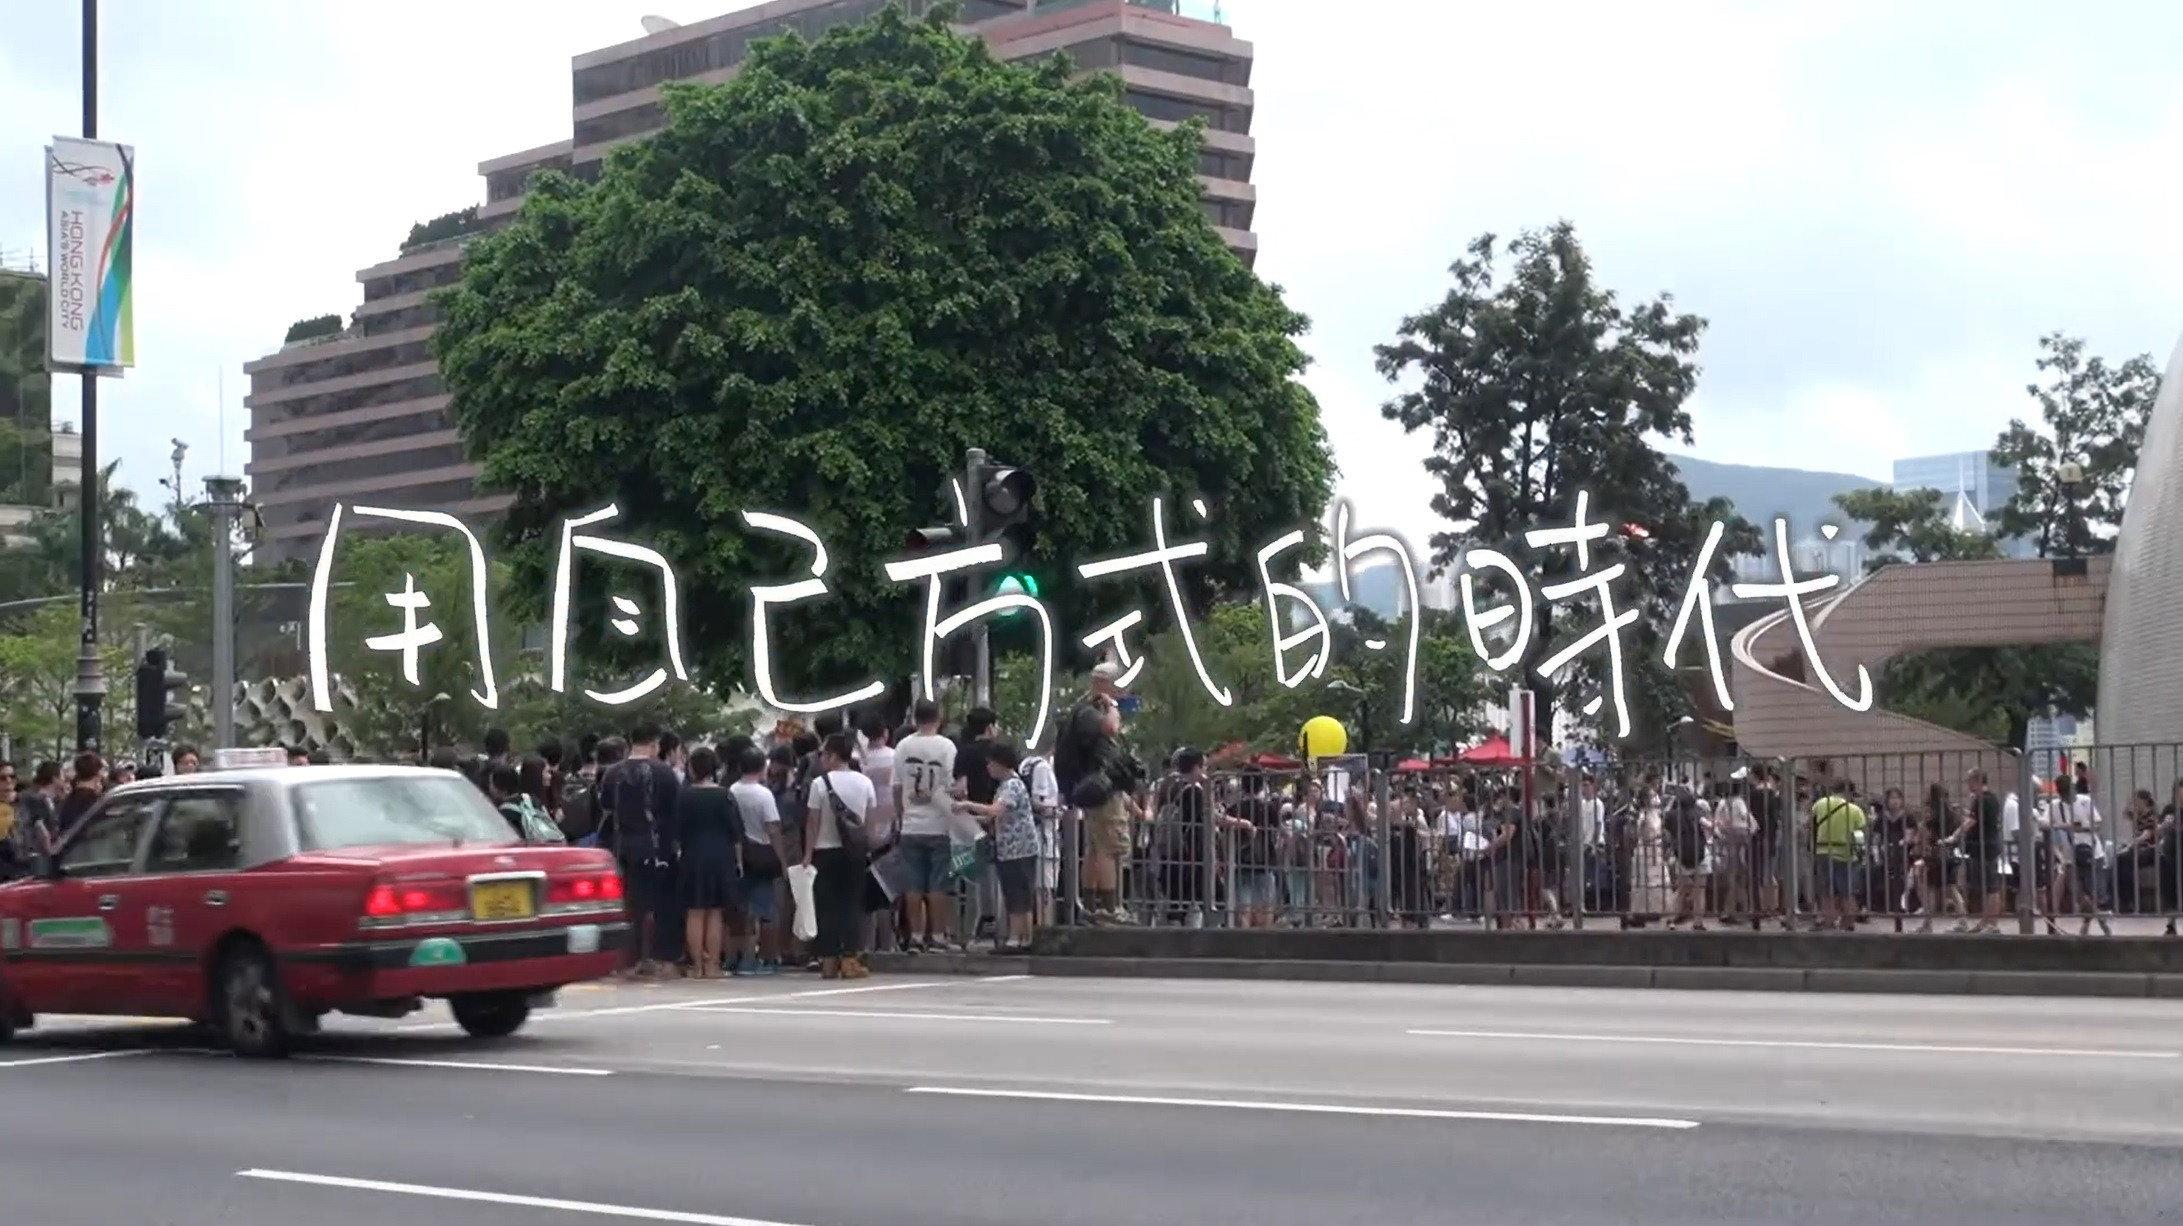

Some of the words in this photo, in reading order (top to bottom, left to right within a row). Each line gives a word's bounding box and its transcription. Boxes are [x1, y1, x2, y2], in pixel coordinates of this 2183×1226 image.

[61, 210, 70, 251] ASIA'S
[70, 210, 84, 270] HONG
[61, 253, 70, 298] WORLD
[61, 299, 70, 329] CITY
[70, 272, 84, 332] KONG
